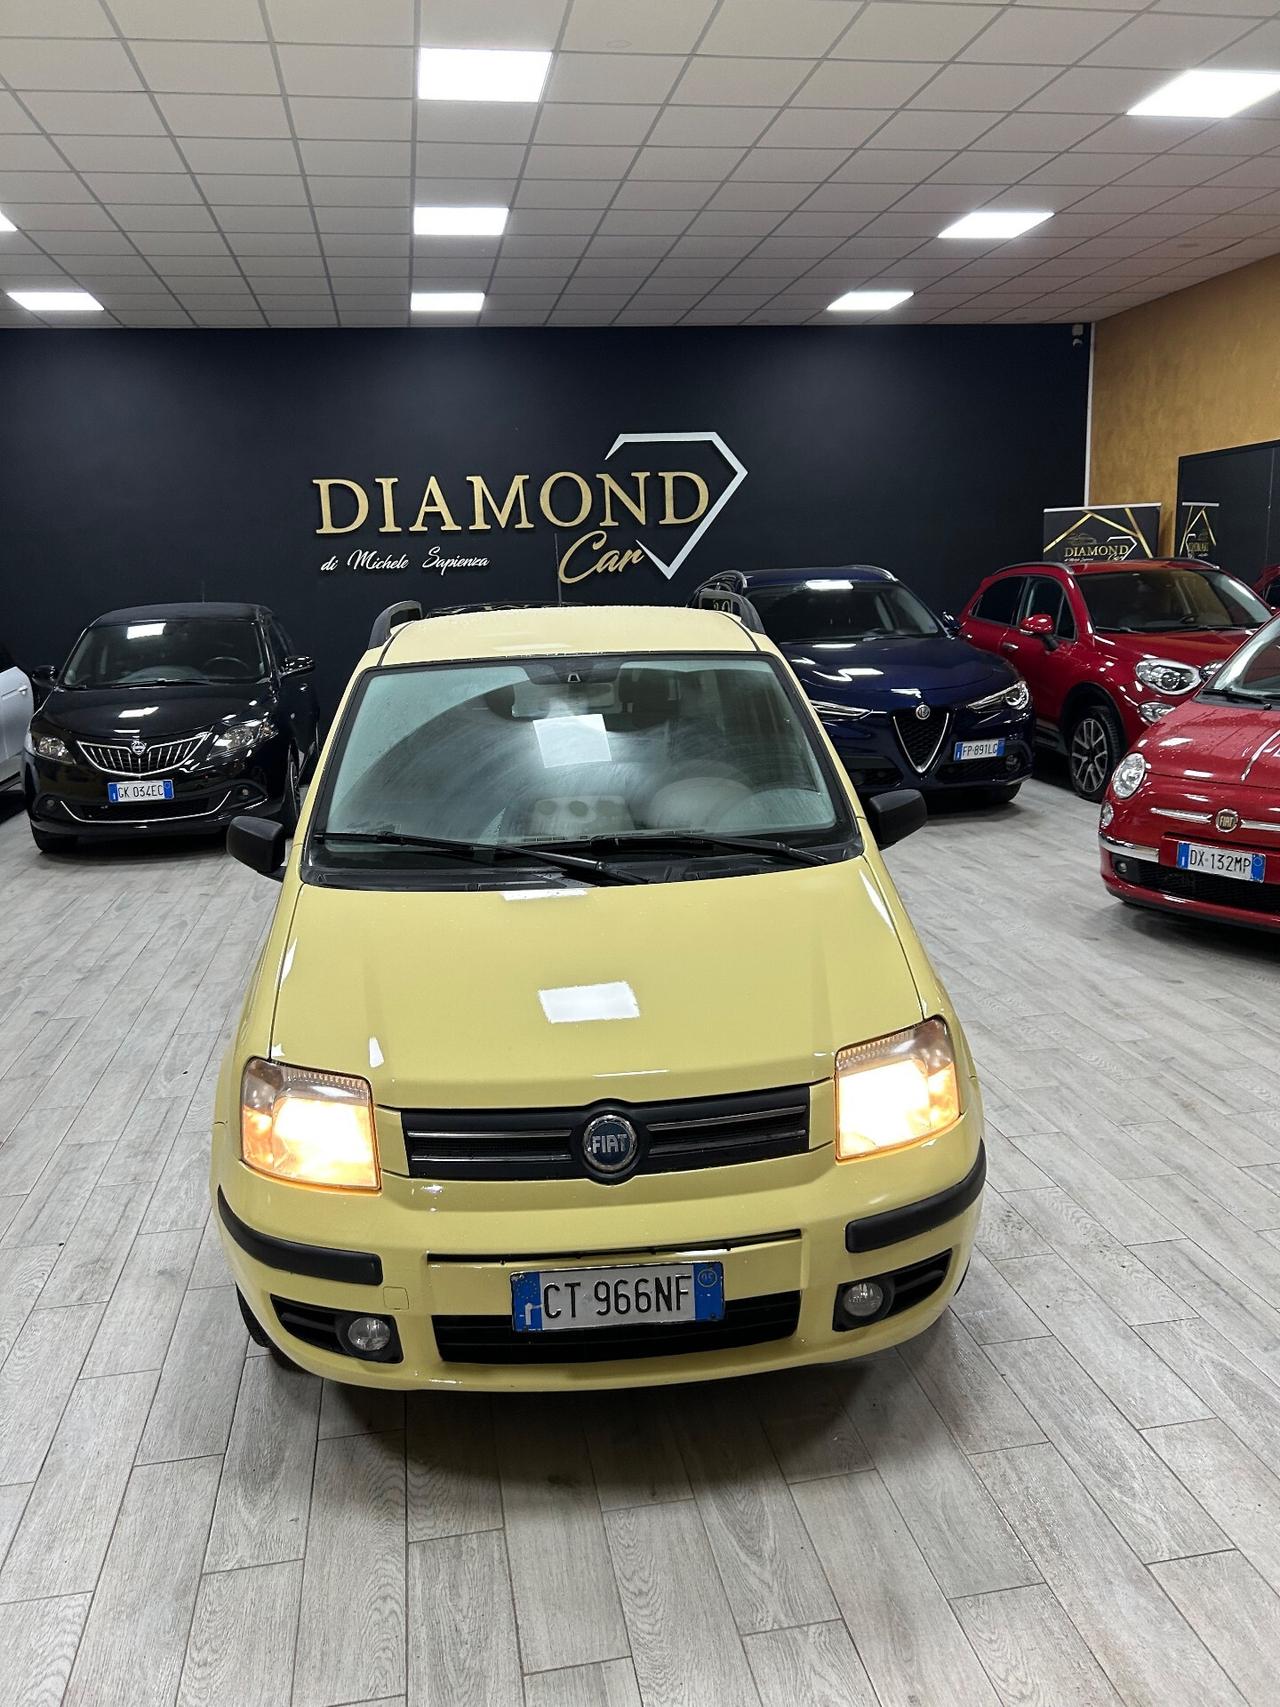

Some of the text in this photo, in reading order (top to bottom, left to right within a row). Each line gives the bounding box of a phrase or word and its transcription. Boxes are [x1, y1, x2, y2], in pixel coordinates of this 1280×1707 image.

[312, 470, 710, 535] DIAMOND
[320, 546, 490, 576] di Michele Sapienza
[558, 530, 645, 584] Car
[1064, 544, 1130, 559] DIAMOND
[117, 786, 130, 799] GK
[132, 784, 164, 798] 034EC
[1218, 815, 1234, 828] FIAT
[1190, 849, 1205, 867] DX
[1210, 853, 1252, 874] 132MP
[591, 1133, 628, 1154] FIAT
[543, 1281, 581, 1319] CT
[593, 1274, 692, 1317] 966NF
